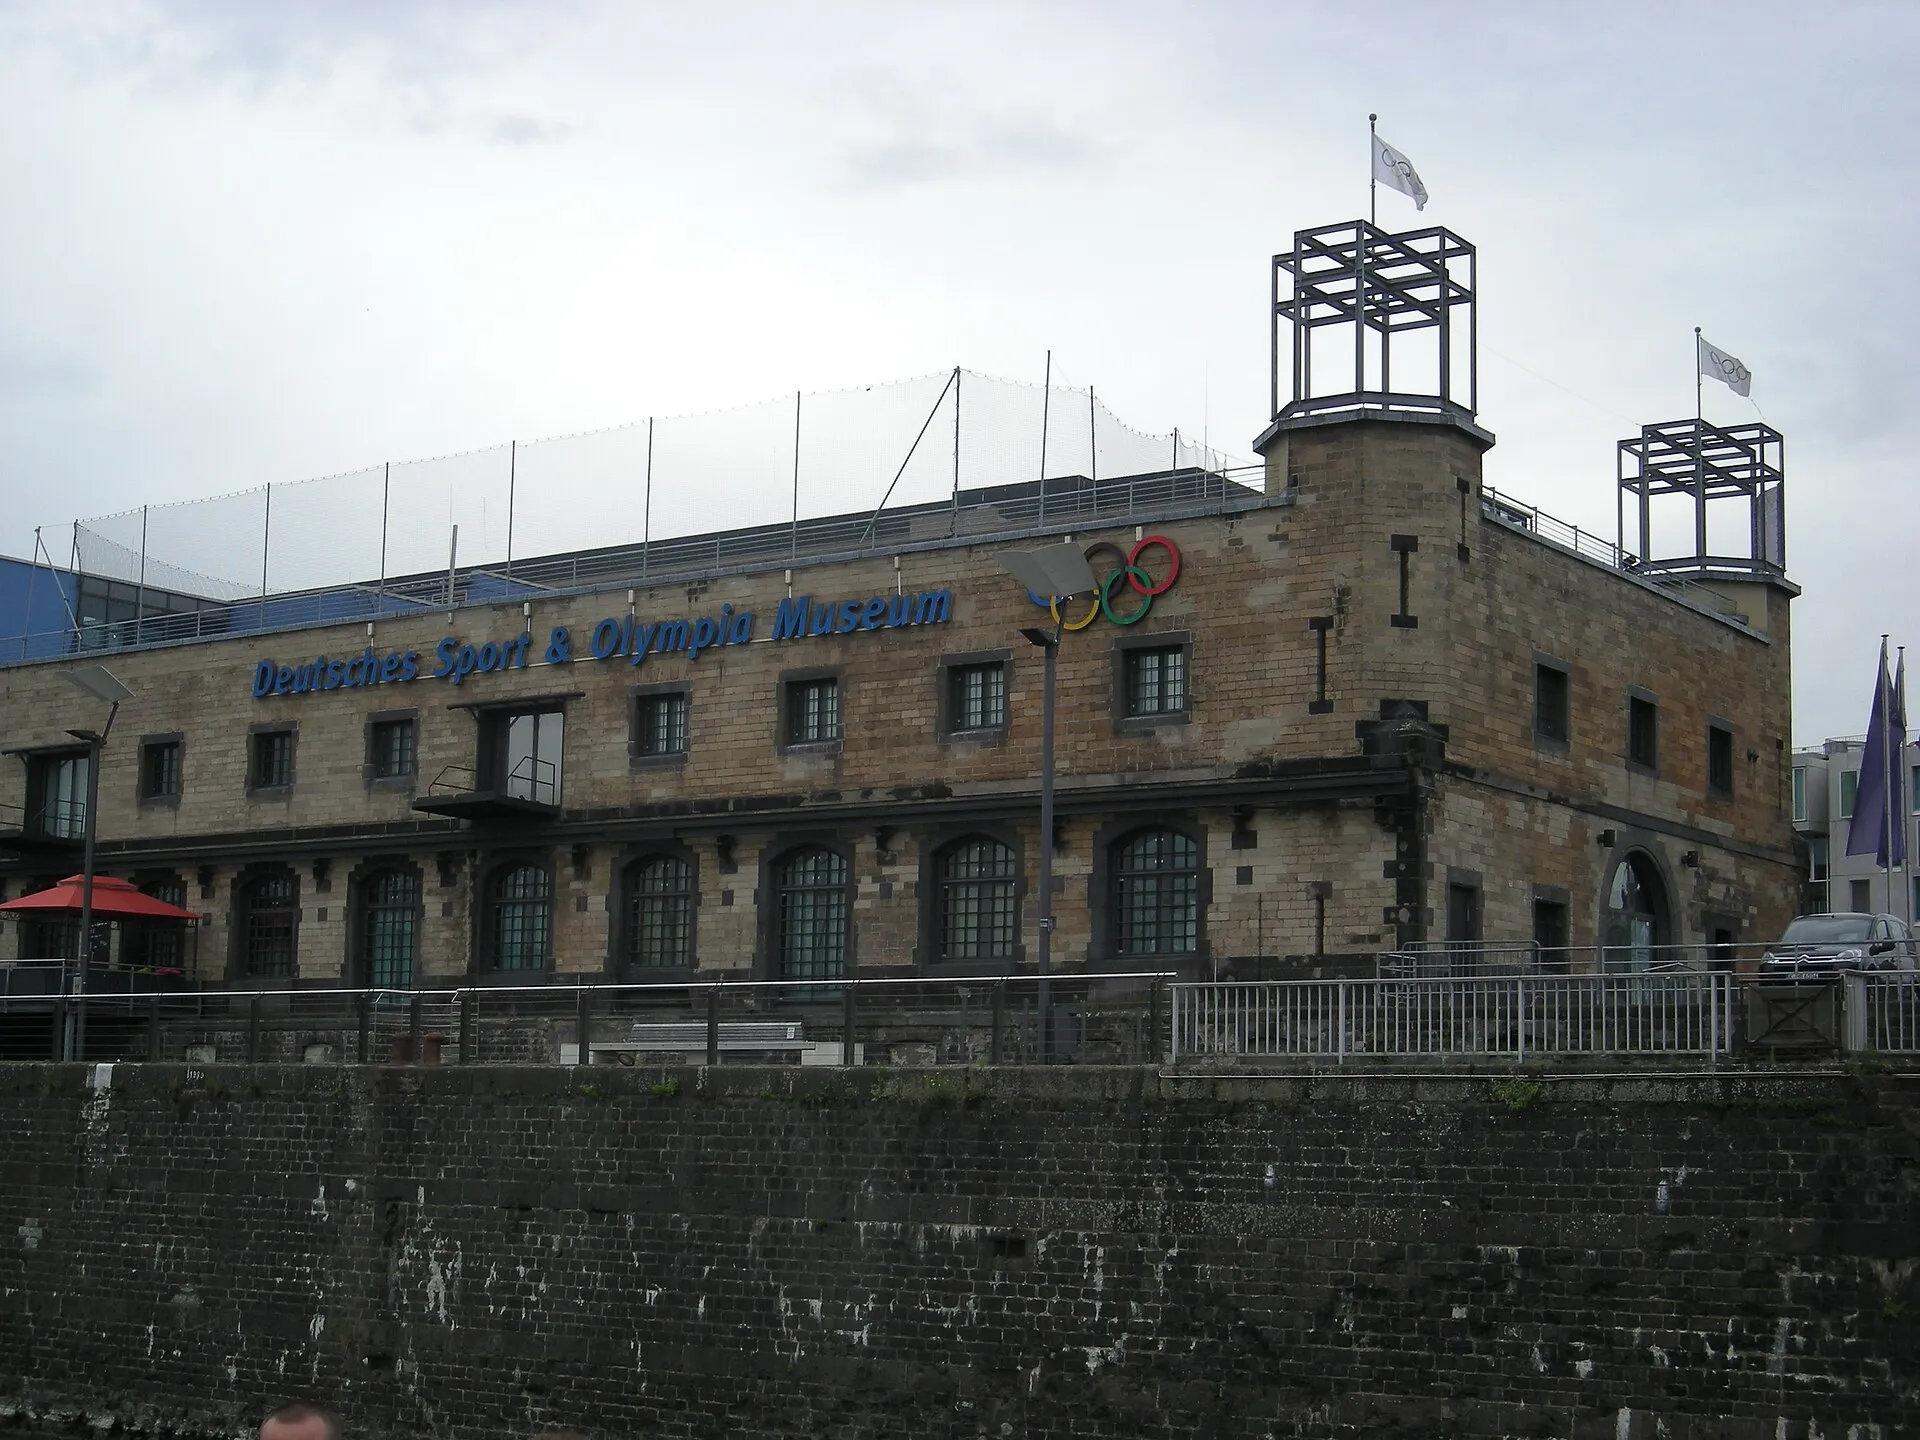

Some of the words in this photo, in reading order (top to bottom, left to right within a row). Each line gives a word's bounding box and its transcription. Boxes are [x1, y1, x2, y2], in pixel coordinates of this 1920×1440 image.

[252, 647, 421, 697] Deutsches
[432, 636, 530, 686] Sport
[544, 626, 572, 665] &
[591, 603, 753, 666] Olympia
[771, 587, 952, 640] Museum
